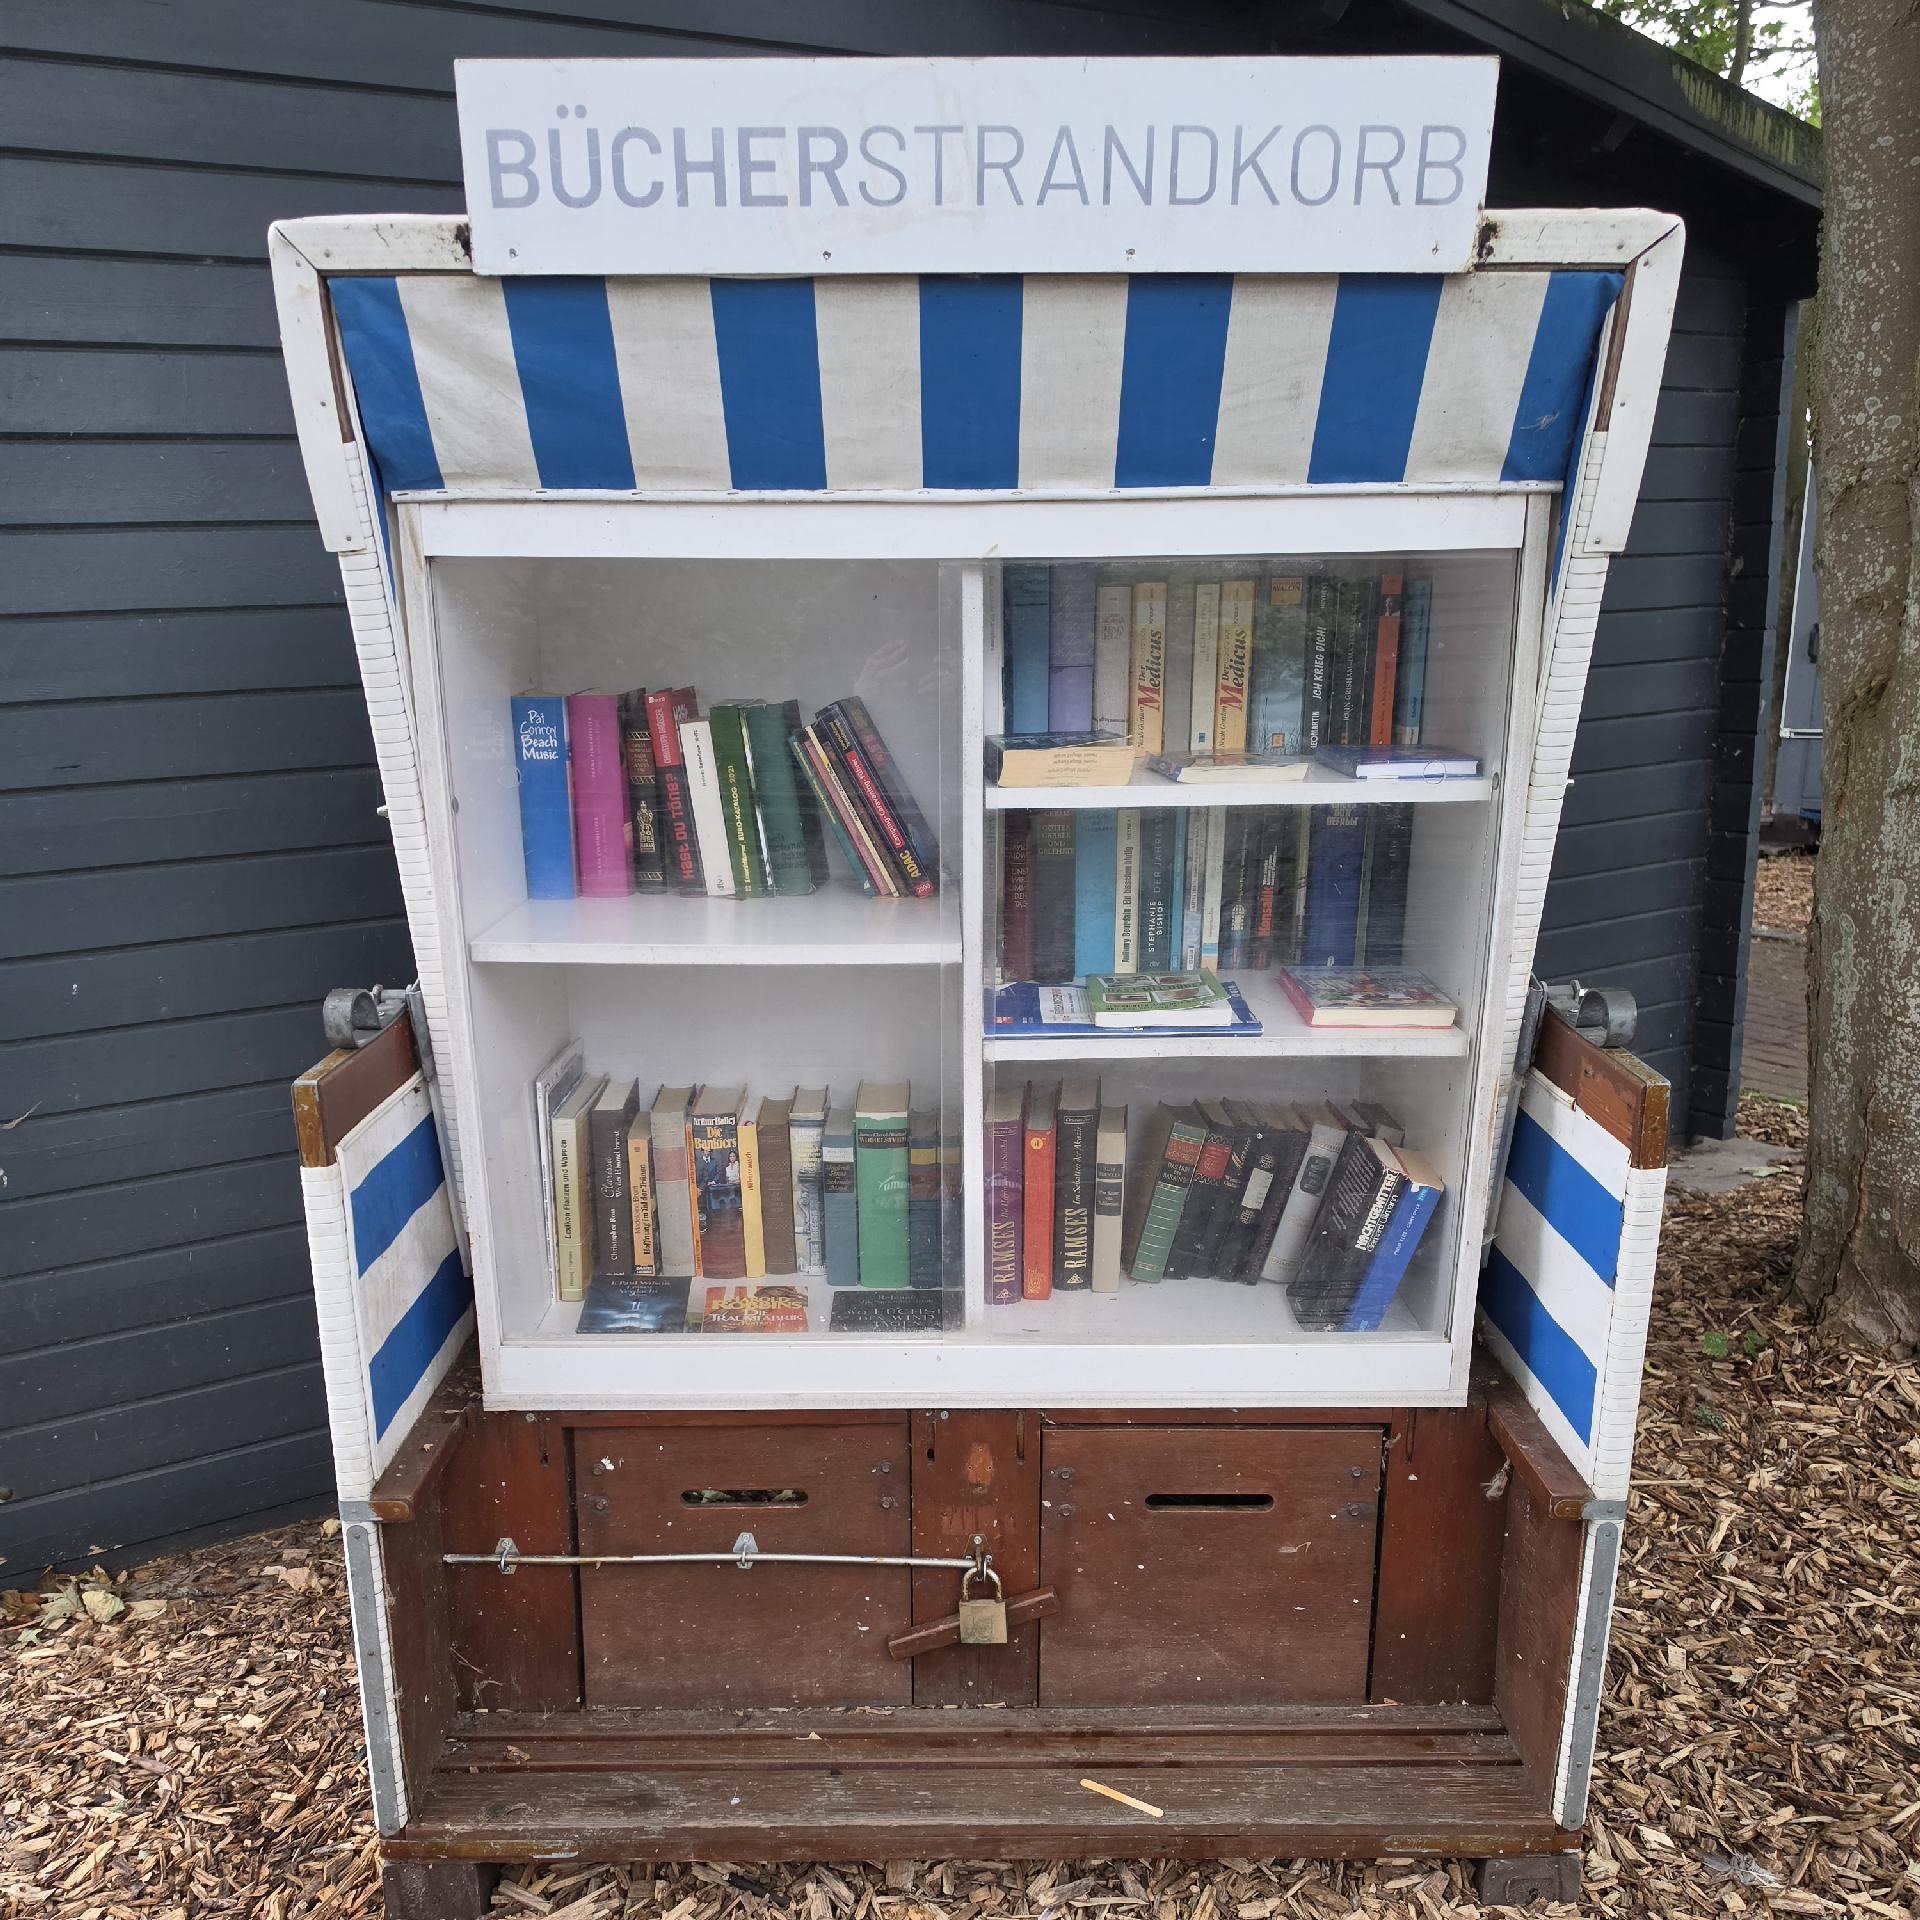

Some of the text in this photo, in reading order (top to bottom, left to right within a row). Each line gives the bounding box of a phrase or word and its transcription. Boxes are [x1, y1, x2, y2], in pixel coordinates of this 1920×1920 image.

[486, 104, 1466, 208] BÜCHERSTRANDKORB
[1138, 629, 1162, 712] Medicus
[1220, 629, 1247, 712] Medicus
[1313, 654, 1324, 681] KRIEG
[1312, 683, 1322, 699] ICH
[520, 722, 557, 737] Conroy
[528, 711, 544, 724] Pat
[521, 735, 557, 748] Beach
[523, 748, 559, 760] Music
[728, 765, 745, 841] EURO-KATALOG 2021
[674, 823, 688, 840] DU
[899, 850, 921, 878] ADAC
[1123, 895, 1132, 906] Ein
[1156, 900, 1164, 935] BISHOP
[694, 1137, 737, 1151] Bankiers
[707, 1126, 722, 1138] Die
[560, 1139, 569, 1167] Wappen
[1071, 1163, 1082, 1192] Schatten
[1072, 1194, 1081, 1205] Im
[1355, 1168, 1401, 1250] NACHTGEWITTER
[564, 1212, 572, 1239] Lexikon
[642, 1221, 652, 1255] Hoffnung
[1064, 1208, 1088, 1268] RAMSES
[610, 1224, 618, 1260] Christopher
[992, 1221, 1016, 1284] RAMSES
[712, 1298, 802, 1310] ROBBINS
